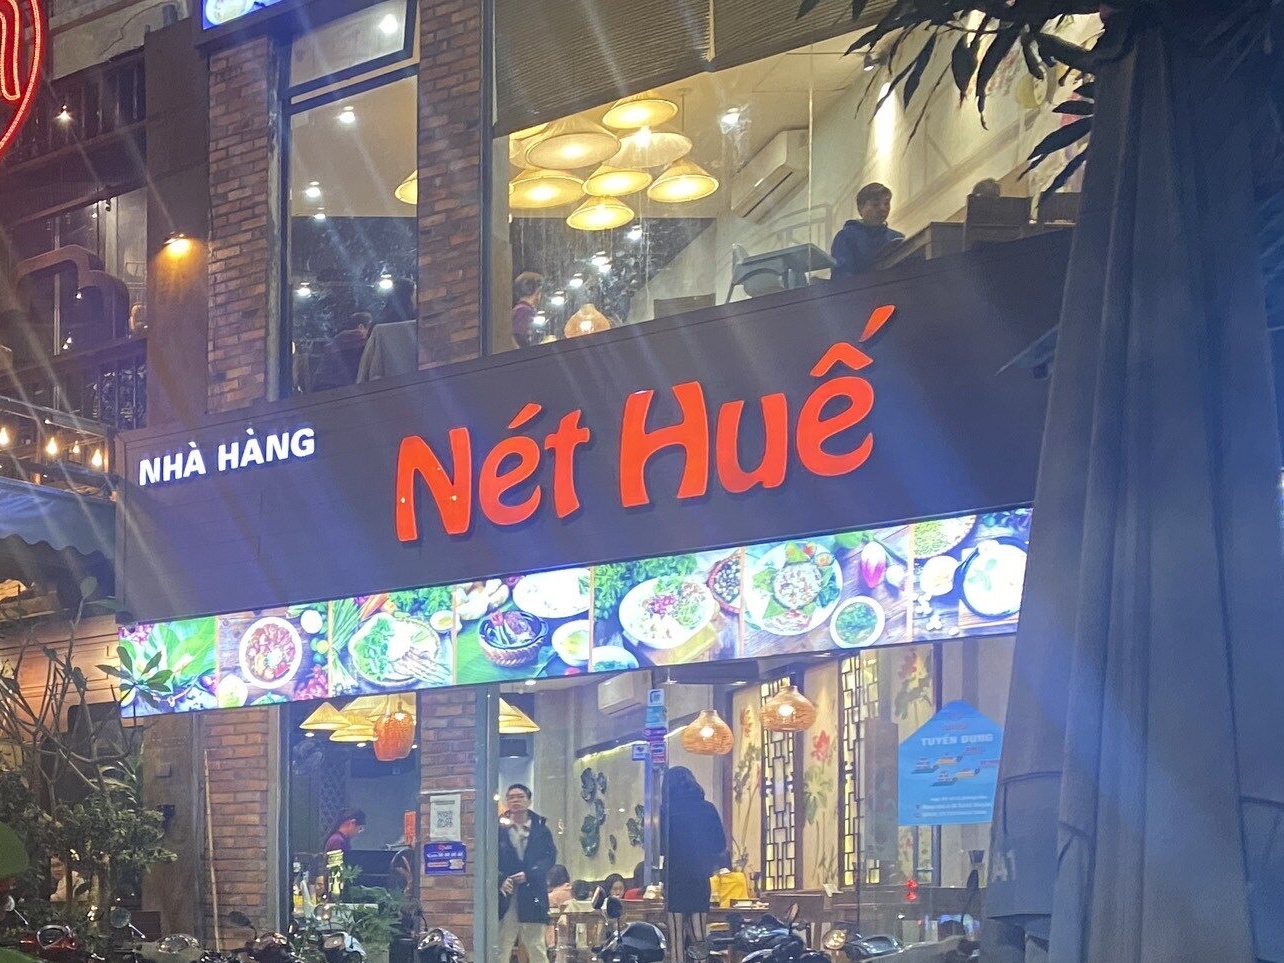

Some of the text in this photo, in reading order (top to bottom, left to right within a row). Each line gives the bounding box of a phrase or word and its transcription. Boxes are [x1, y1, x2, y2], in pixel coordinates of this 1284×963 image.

[139, 428, 315, 486] NHÀ HÀNG
[396, 305, 895, 542] Nét Huế
